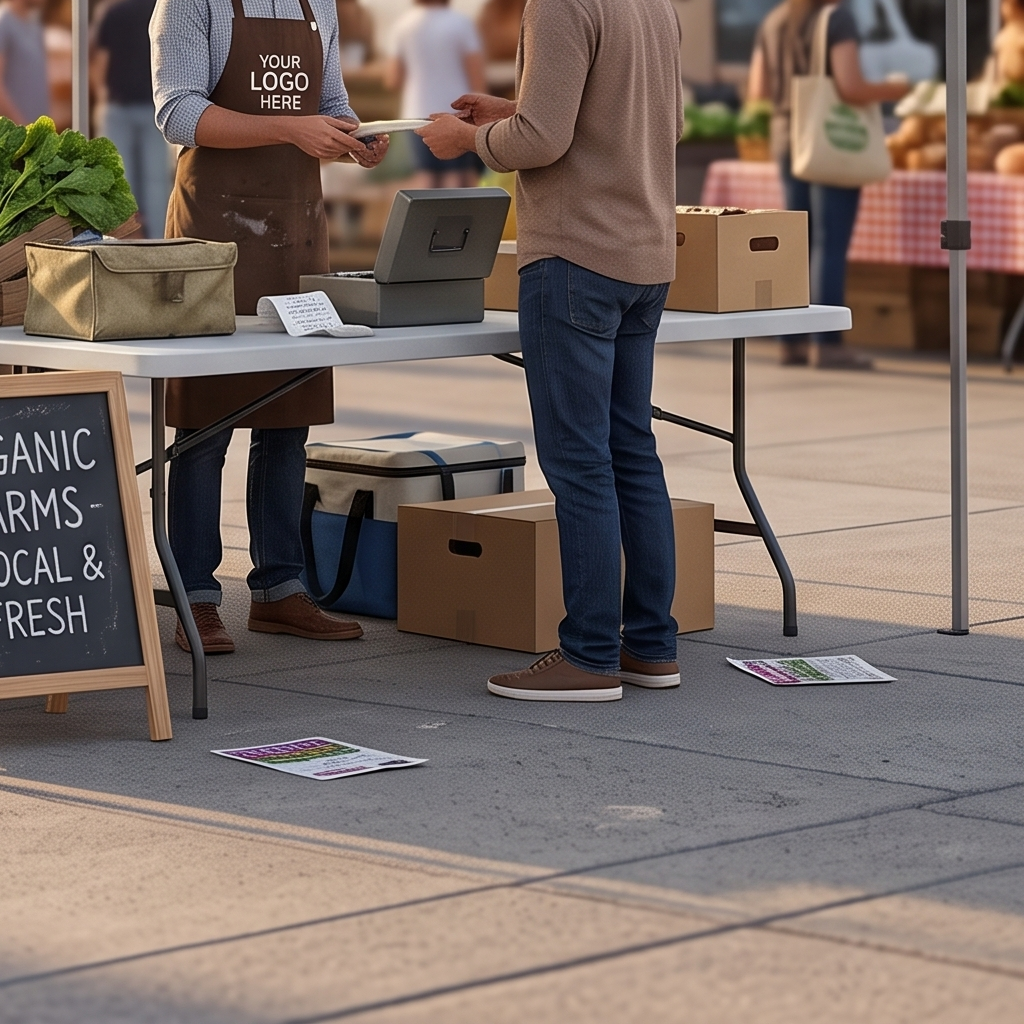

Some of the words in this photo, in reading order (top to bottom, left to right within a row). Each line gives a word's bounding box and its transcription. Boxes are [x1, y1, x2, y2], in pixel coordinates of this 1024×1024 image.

[259, 54, 301, 69] YOUR
[250, 71, 309, 92] LOGO
[260, 94, 302, 110] HERE
[82, 543, 105, 581] &
